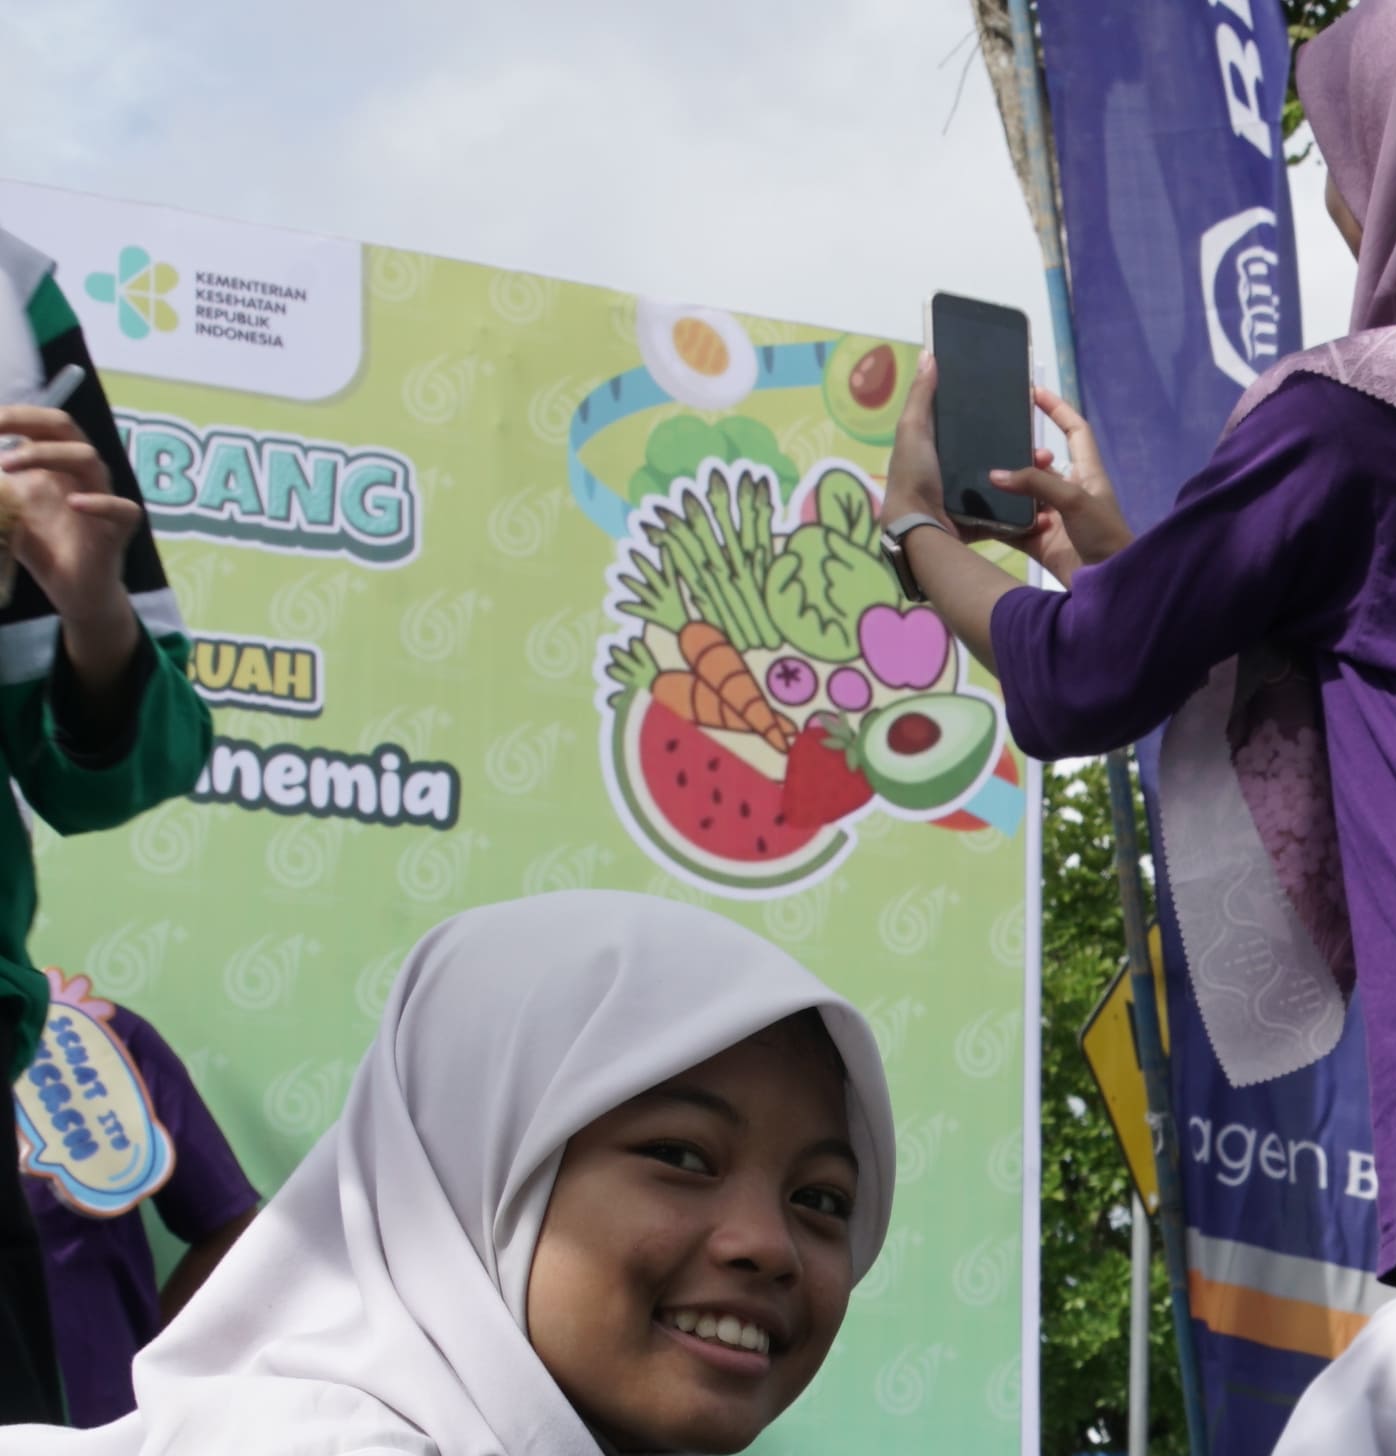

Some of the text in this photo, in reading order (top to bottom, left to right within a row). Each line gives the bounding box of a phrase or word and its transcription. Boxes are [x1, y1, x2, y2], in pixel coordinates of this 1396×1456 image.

[196, 271, 307, 302] KEMENTERIAN
[196, 288, 287, 315] KESEHATAN
[196, 304, 271, 329] REPUBLIK
[195, 322, 284, 348] INDONESIA
[112, 426, 402, 539] BANG
[187, 639, 315, 700] UAH
[195, 745, 453, 822] nemia
[97, 1110, 131, 1151] ITU
